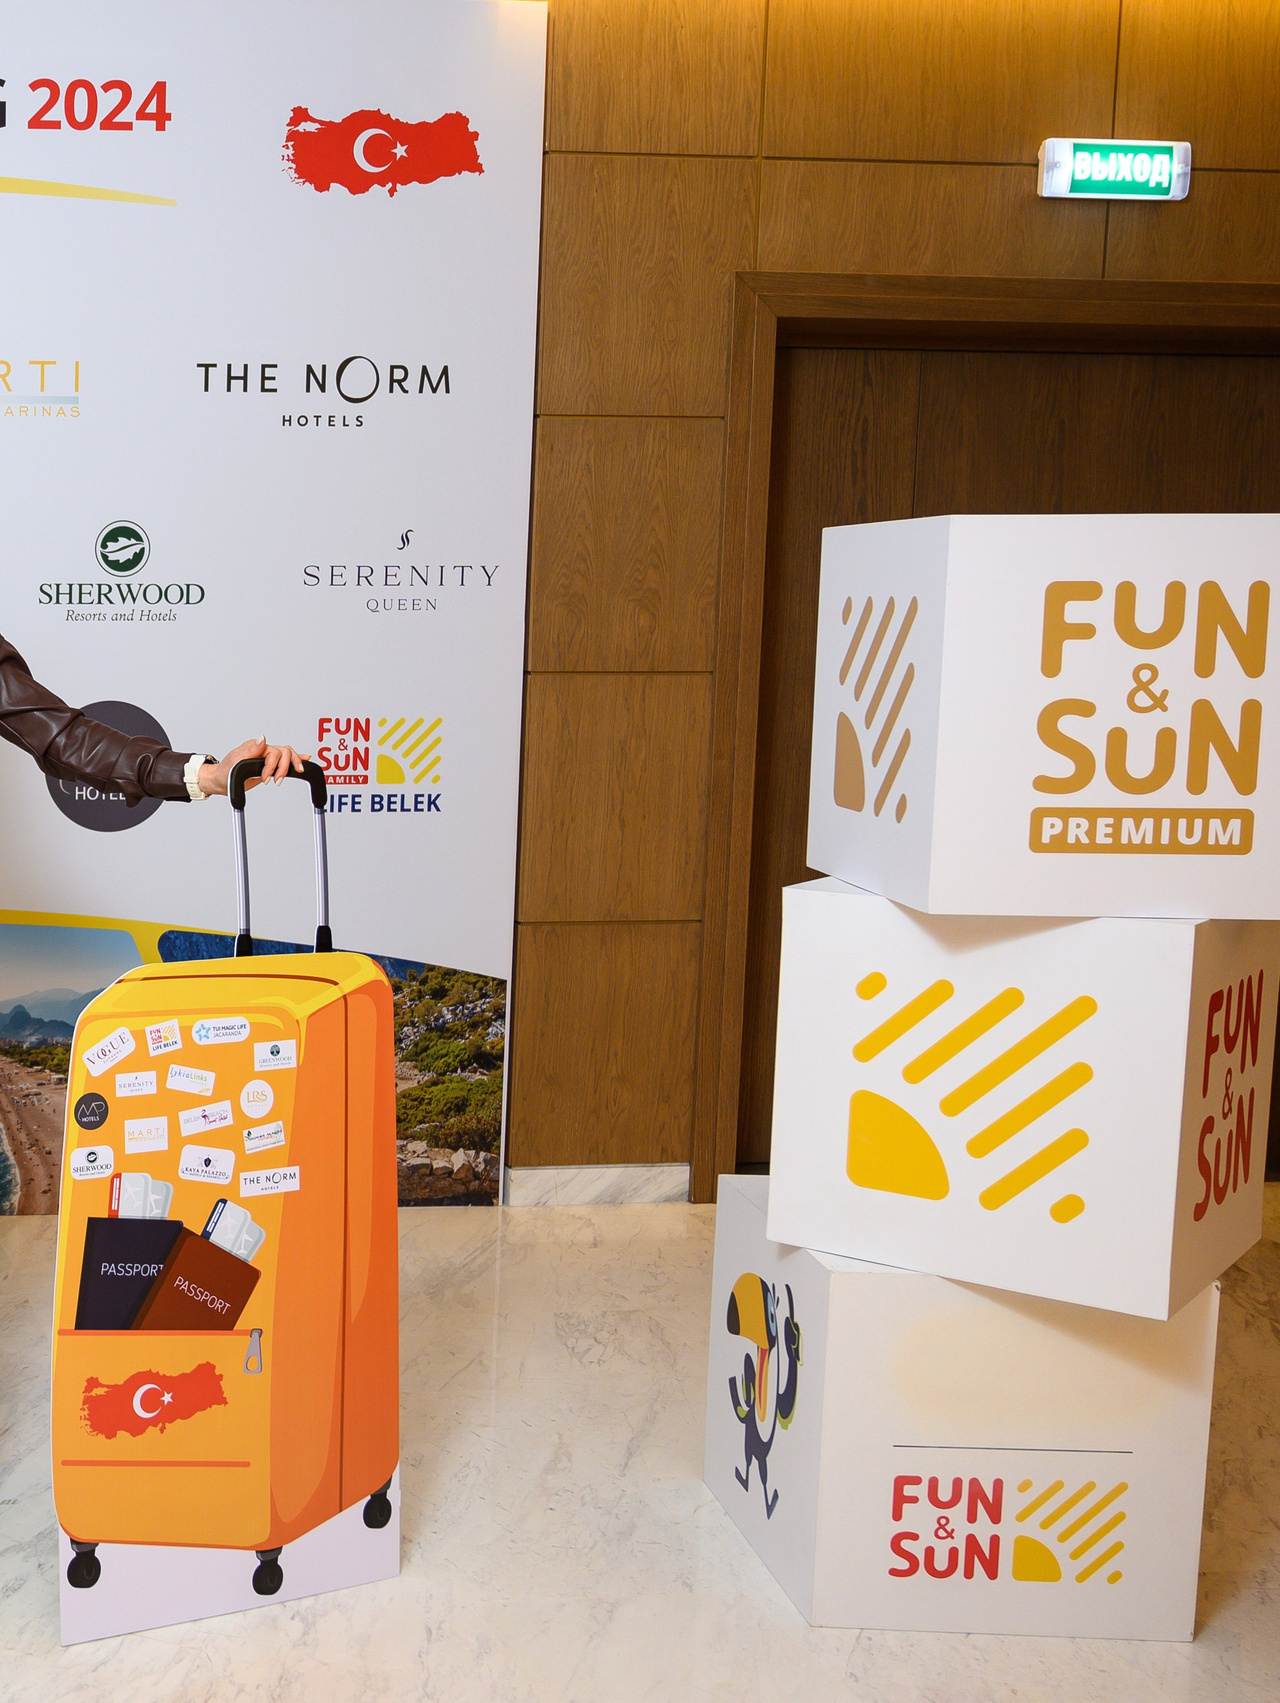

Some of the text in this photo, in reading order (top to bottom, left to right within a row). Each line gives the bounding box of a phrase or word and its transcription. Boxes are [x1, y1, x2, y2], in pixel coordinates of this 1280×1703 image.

[27, 77, 172, 132] 2024
[1074, 151, 1170, 188] ВЫХОД
[197, 355, 451, 404] THE NORM
[282, 414, 364, 427] HOTELS
[303, 564, 499, 587] SERENITY
[38, 583, 205, 605] SHERWOOD
[366, 598, 438, 613] QUEEN
[65, 609, 177, 622] Resorts and Hotels
[1040, 580, 1270, 679] FUN
[1126, 662, 1169, 714] &
[317, 717, 370, 743] FUN
[338, 738, 348, 751] &
[1032, 698, 1262, 796] SUN
[327, 775, 364, 783] AMILY
[325, 793, 442, 812] IFE BELEK
[1041, 817, 1242, 846] PREMIUM
[1202, 968, 1264, 1099] FUN
[152, 1044, 163, 1052] LIFE
[1222, 1067, 1233, 1120] &
[127, 1127, 165, 1137] MARTI
[1193, 1086, 1255, 1222] SUN
[73, 1163, 112, 1173] SHERWOOD
[200, 1168, 226, 1177] PALAZZO
[243, 1172, 296, 1185] THE NORM
[174, 1276, 231, 1315] PASSPORT
[892, 1475, 1004, 1525] FUN
[933, 1515, 955, 1540] &
[888, 1531, 1001, 1581] SUN
